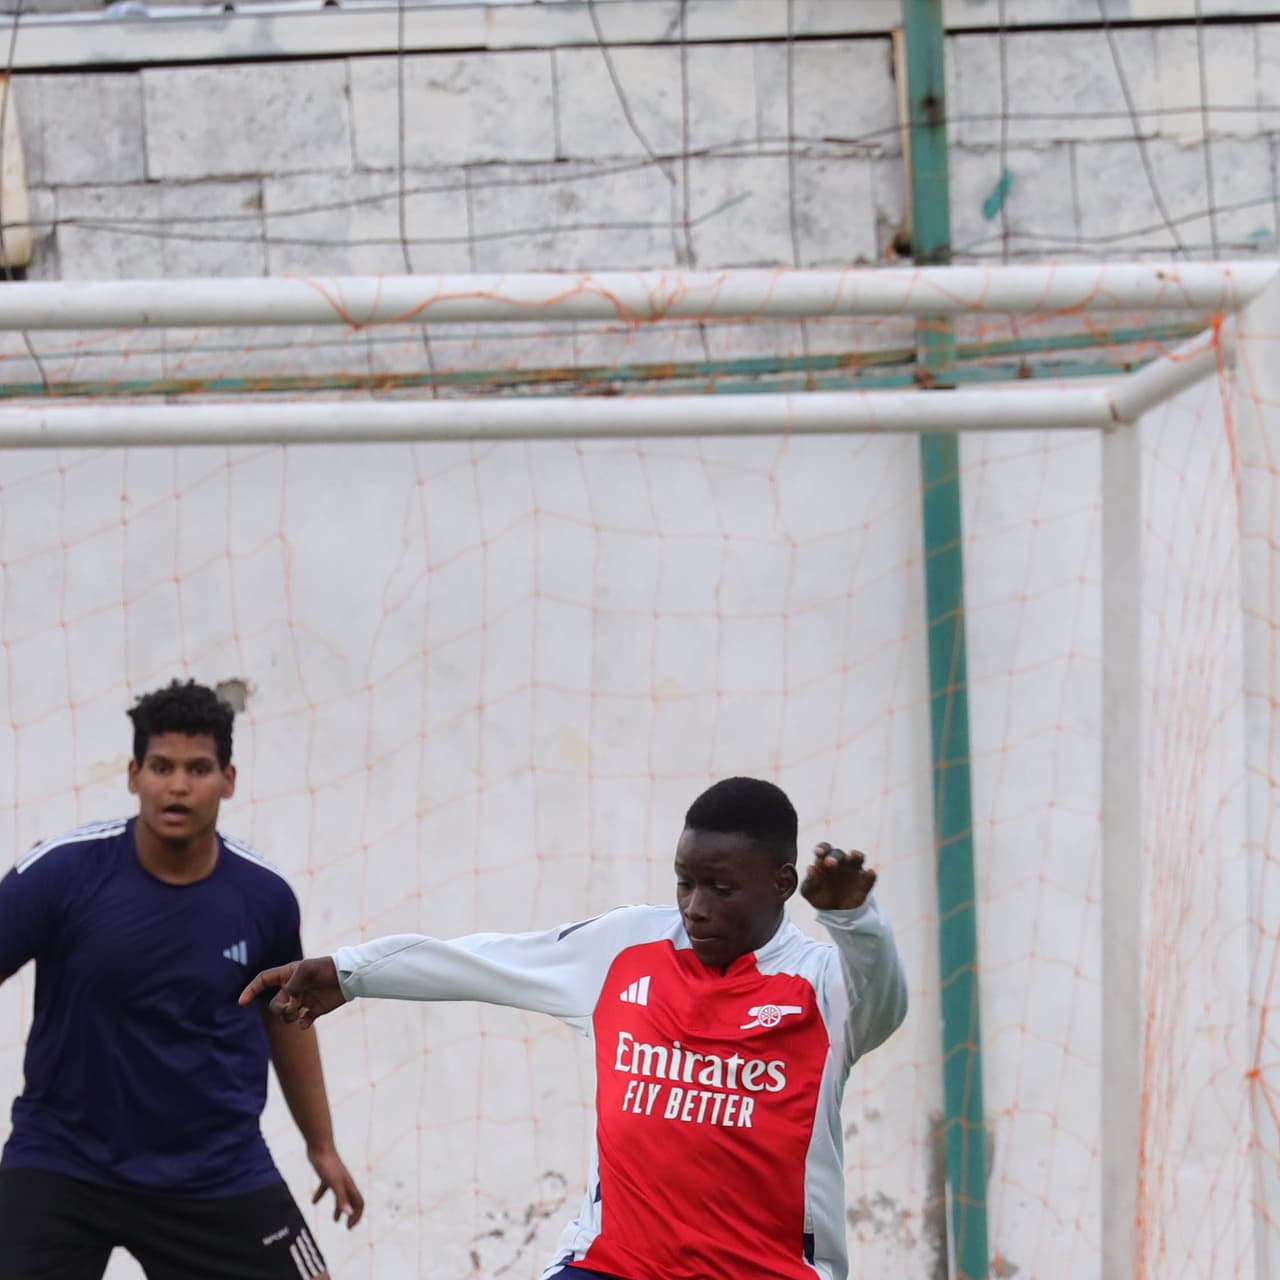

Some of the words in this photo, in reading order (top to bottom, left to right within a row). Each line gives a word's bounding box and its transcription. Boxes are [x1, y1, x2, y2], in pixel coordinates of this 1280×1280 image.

[614, 1031, 787, 1093] Emirates
[622, 1080, 662, 1116] FLY
[663, 1087, 755, 1128] BETTER
